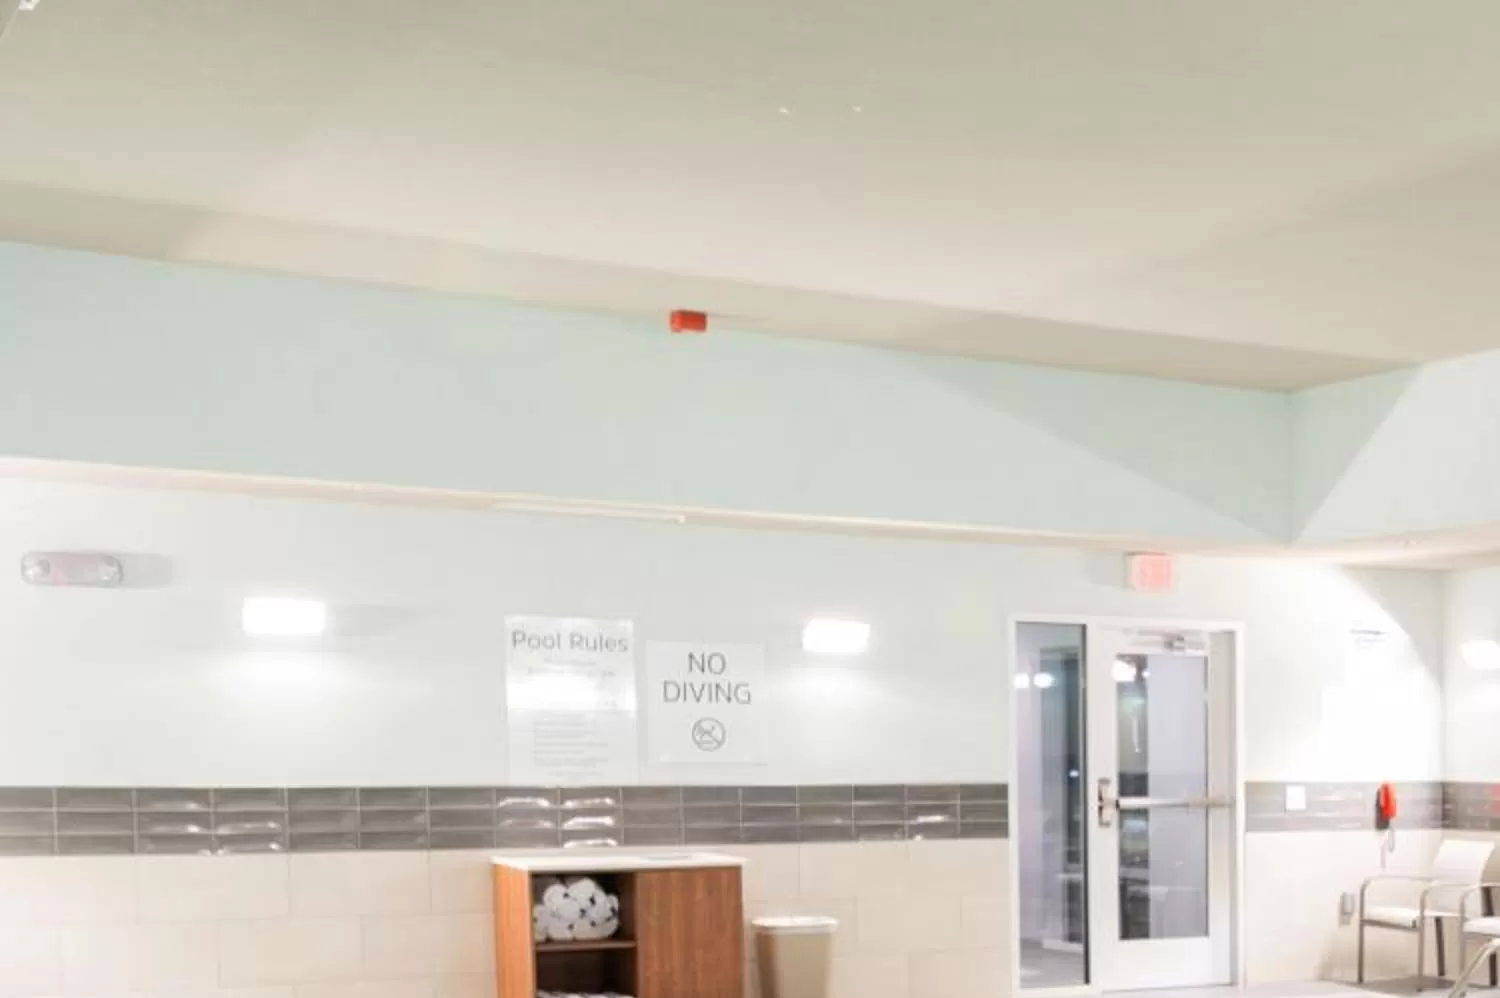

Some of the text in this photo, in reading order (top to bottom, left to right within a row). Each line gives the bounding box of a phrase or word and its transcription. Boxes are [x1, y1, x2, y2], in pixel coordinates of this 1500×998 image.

[511, 629, 629, 653] Pool Rules
[688, 652, 727, 675] NO
[663, 680, 752, 704] DIVING
